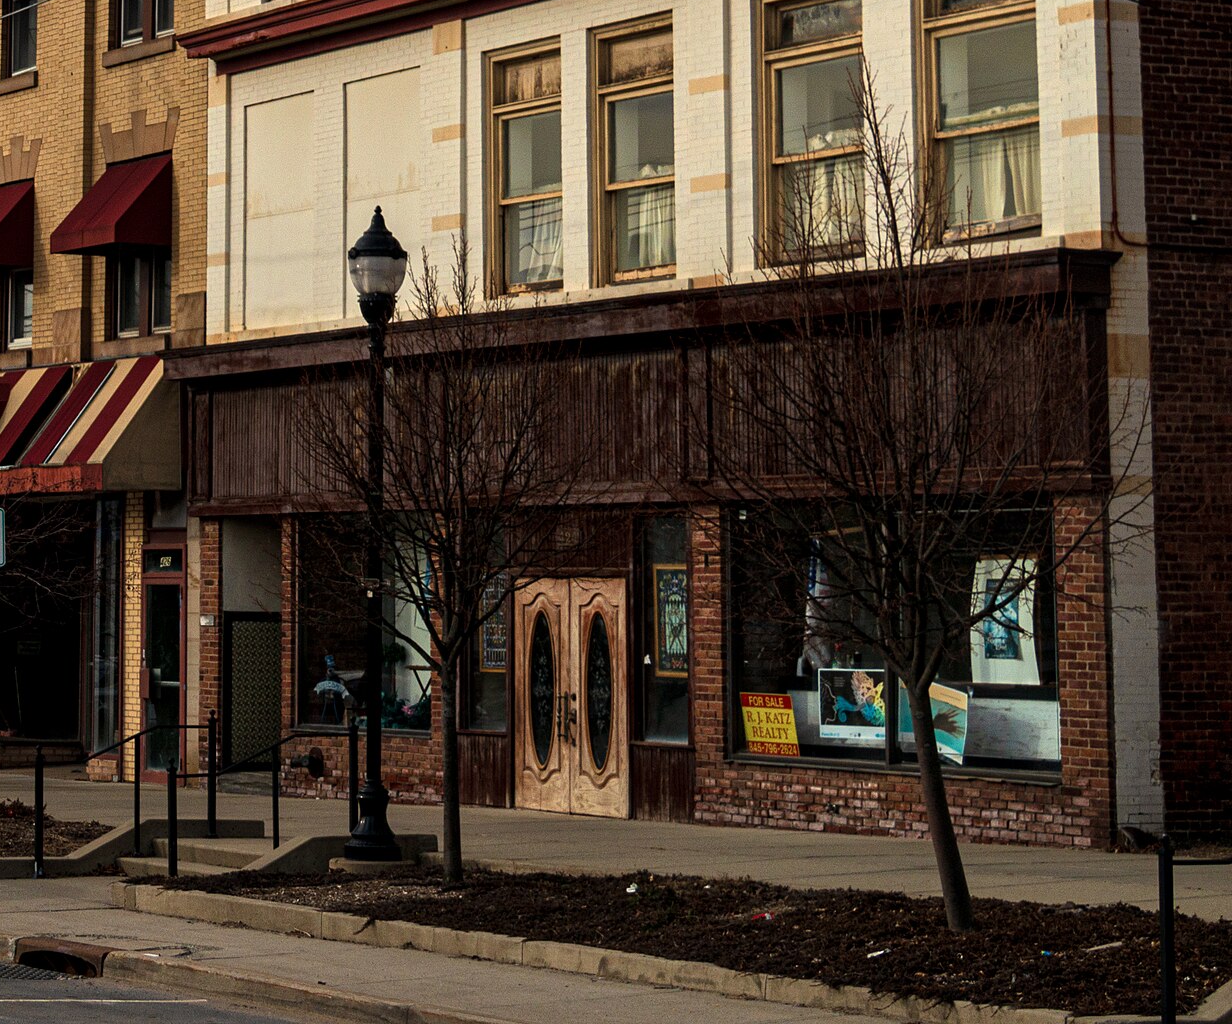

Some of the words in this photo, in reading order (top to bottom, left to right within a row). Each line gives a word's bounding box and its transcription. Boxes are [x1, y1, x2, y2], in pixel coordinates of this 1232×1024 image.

[749, 696, 764, 706] FOR
[765, 697, 784, 707] SALE
[746, 710, 757, 723] R.
[757, 711, 764, 726] J.
[765, 711, 792, 725] KATZ
[752, 726, 788, 739] REALTY
